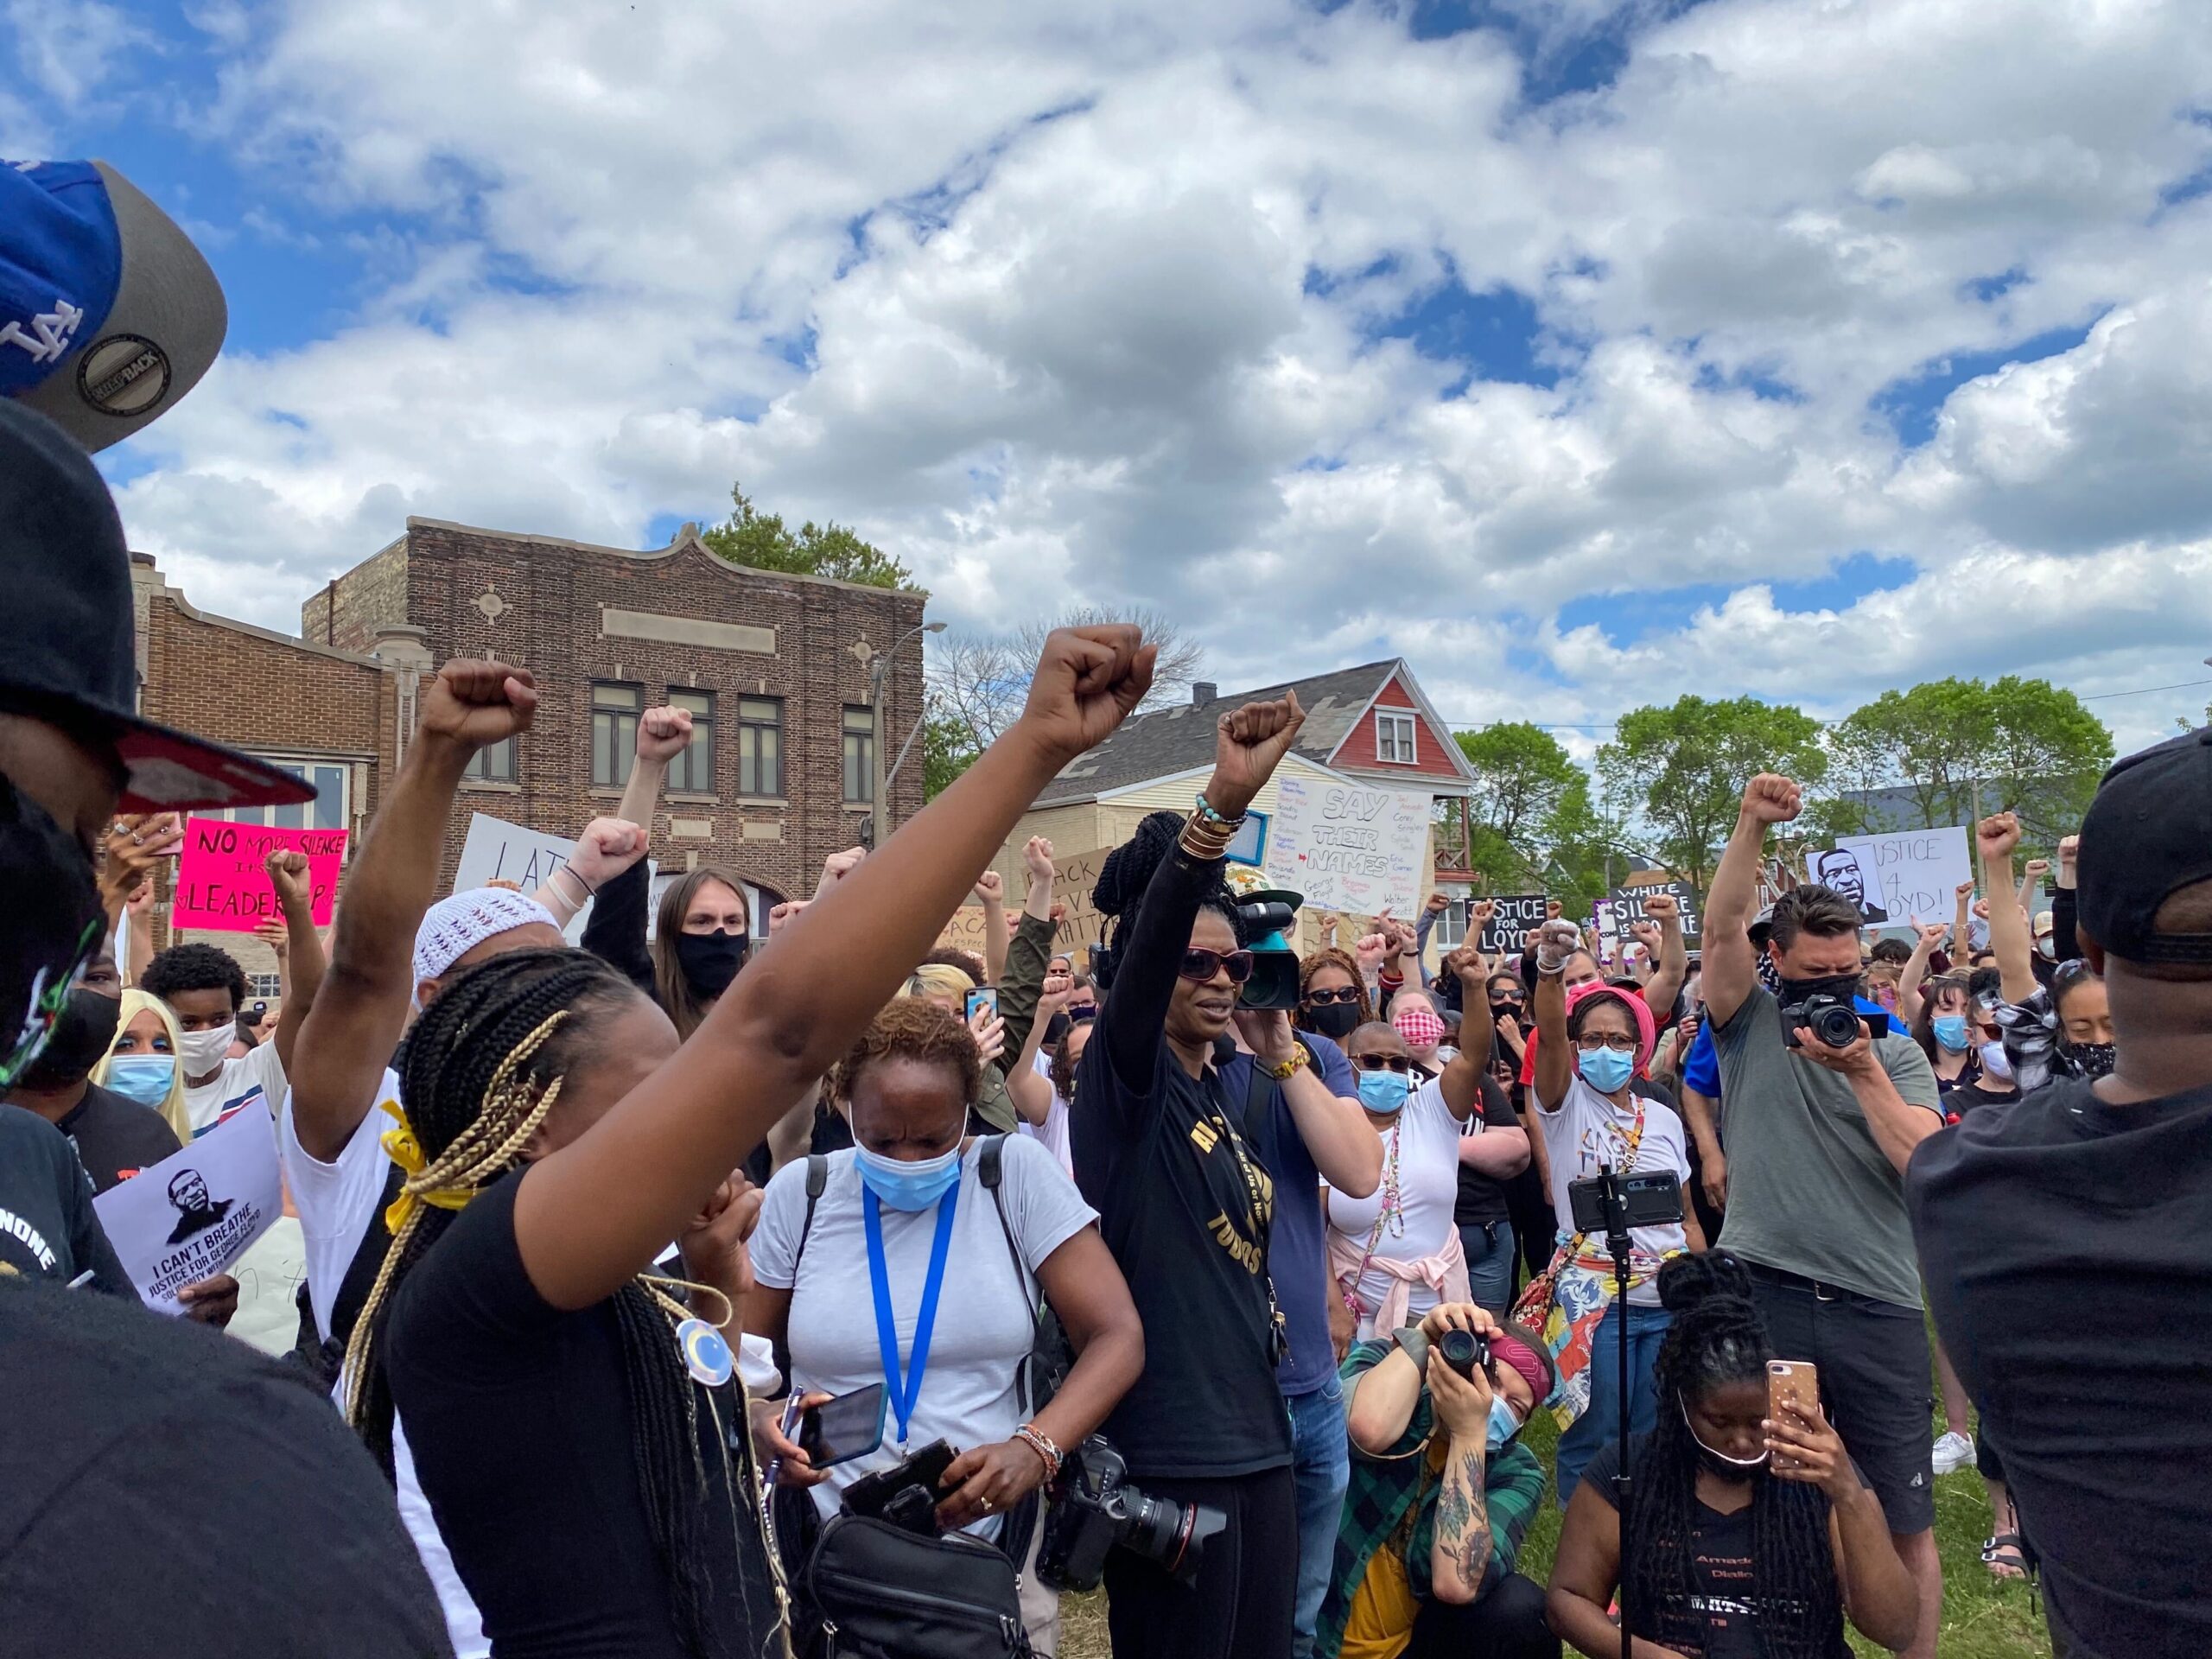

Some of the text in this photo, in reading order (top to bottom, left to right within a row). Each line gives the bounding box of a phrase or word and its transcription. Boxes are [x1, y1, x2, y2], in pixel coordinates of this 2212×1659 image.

[0, 299, 83, 364] LA
[1322, 789, 1389, 822] SAY
[198, 829, 238, 854] NO
[299, 835, 346, 856] SILENCE
[1313, 825, 1379, 852] THEIR
[1027, 860, 1097, 889] ACK
[1306, 849, 1389, 878] NAMES
[1304, 877, 1334, 893] George
[1313, 886, 1333, 899] Floyd
[1618, 883, 1680, 898] WHITE
[1886, 873, 1901, 899] 4
[188, 883, 326, 918] LEADERP
[1468, 899, 1545, 920] STICE
[1614, 896, 1691, 920] SILE
[1496, 918, 1519, 929] FOR
[1618, 923, 1630, 935] IS
[1481, 930, 1529, 950] LOYD
[1243, 1163, 1251, 1173] of
[1248, 1175, 1255, 1187] Us
[1251, 1189, 1258, 1200] or
[153, 1266, 159, 1279] I
[161, 1242, 201, 1274] CAN'T
[204, 1202, 251, 1249] BREATHE
[149, 1268, 188, 1298] JUSTICE
[188, 1256, 209, 1274] FOR
[210, 1233, 238, 1261] GEORGE
[162, 1271, 206, 1302] SOLIDARITY
